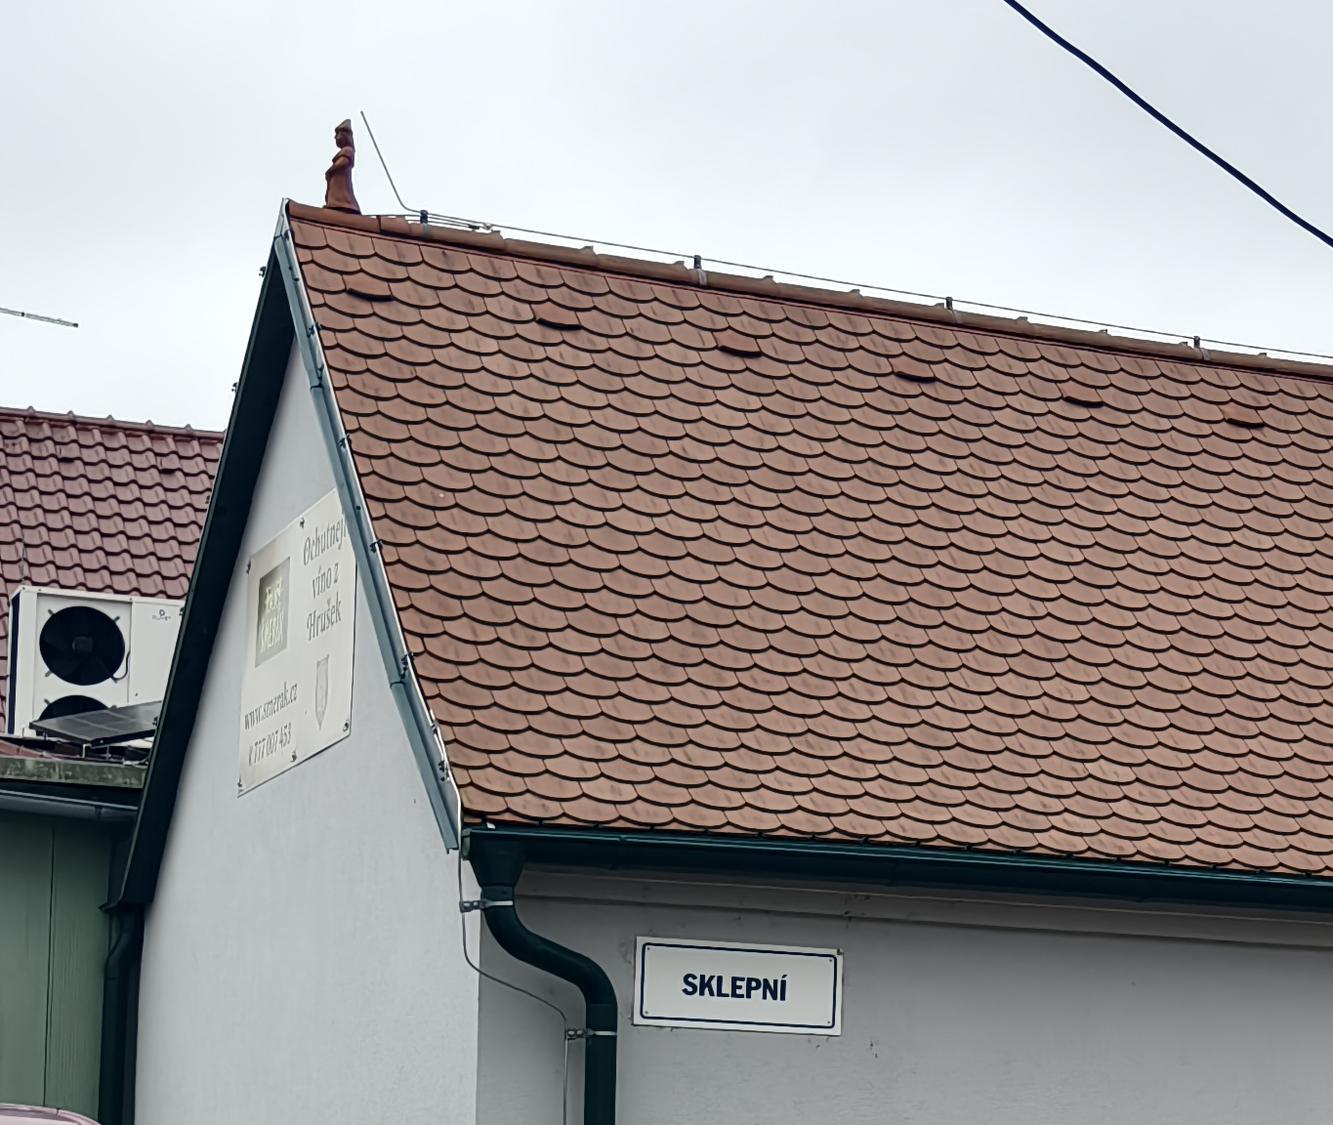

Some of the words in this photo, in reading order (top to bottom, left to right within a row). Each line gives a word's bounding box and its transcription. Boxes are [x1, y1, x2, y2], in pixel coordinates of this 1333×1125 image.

[312, 564, 332, 599] víno
[333, 562, 339, 584] z
[306, 591, 342, 641] Hrušek
[681, 973, 788, 1001] SKLEPNÍ
